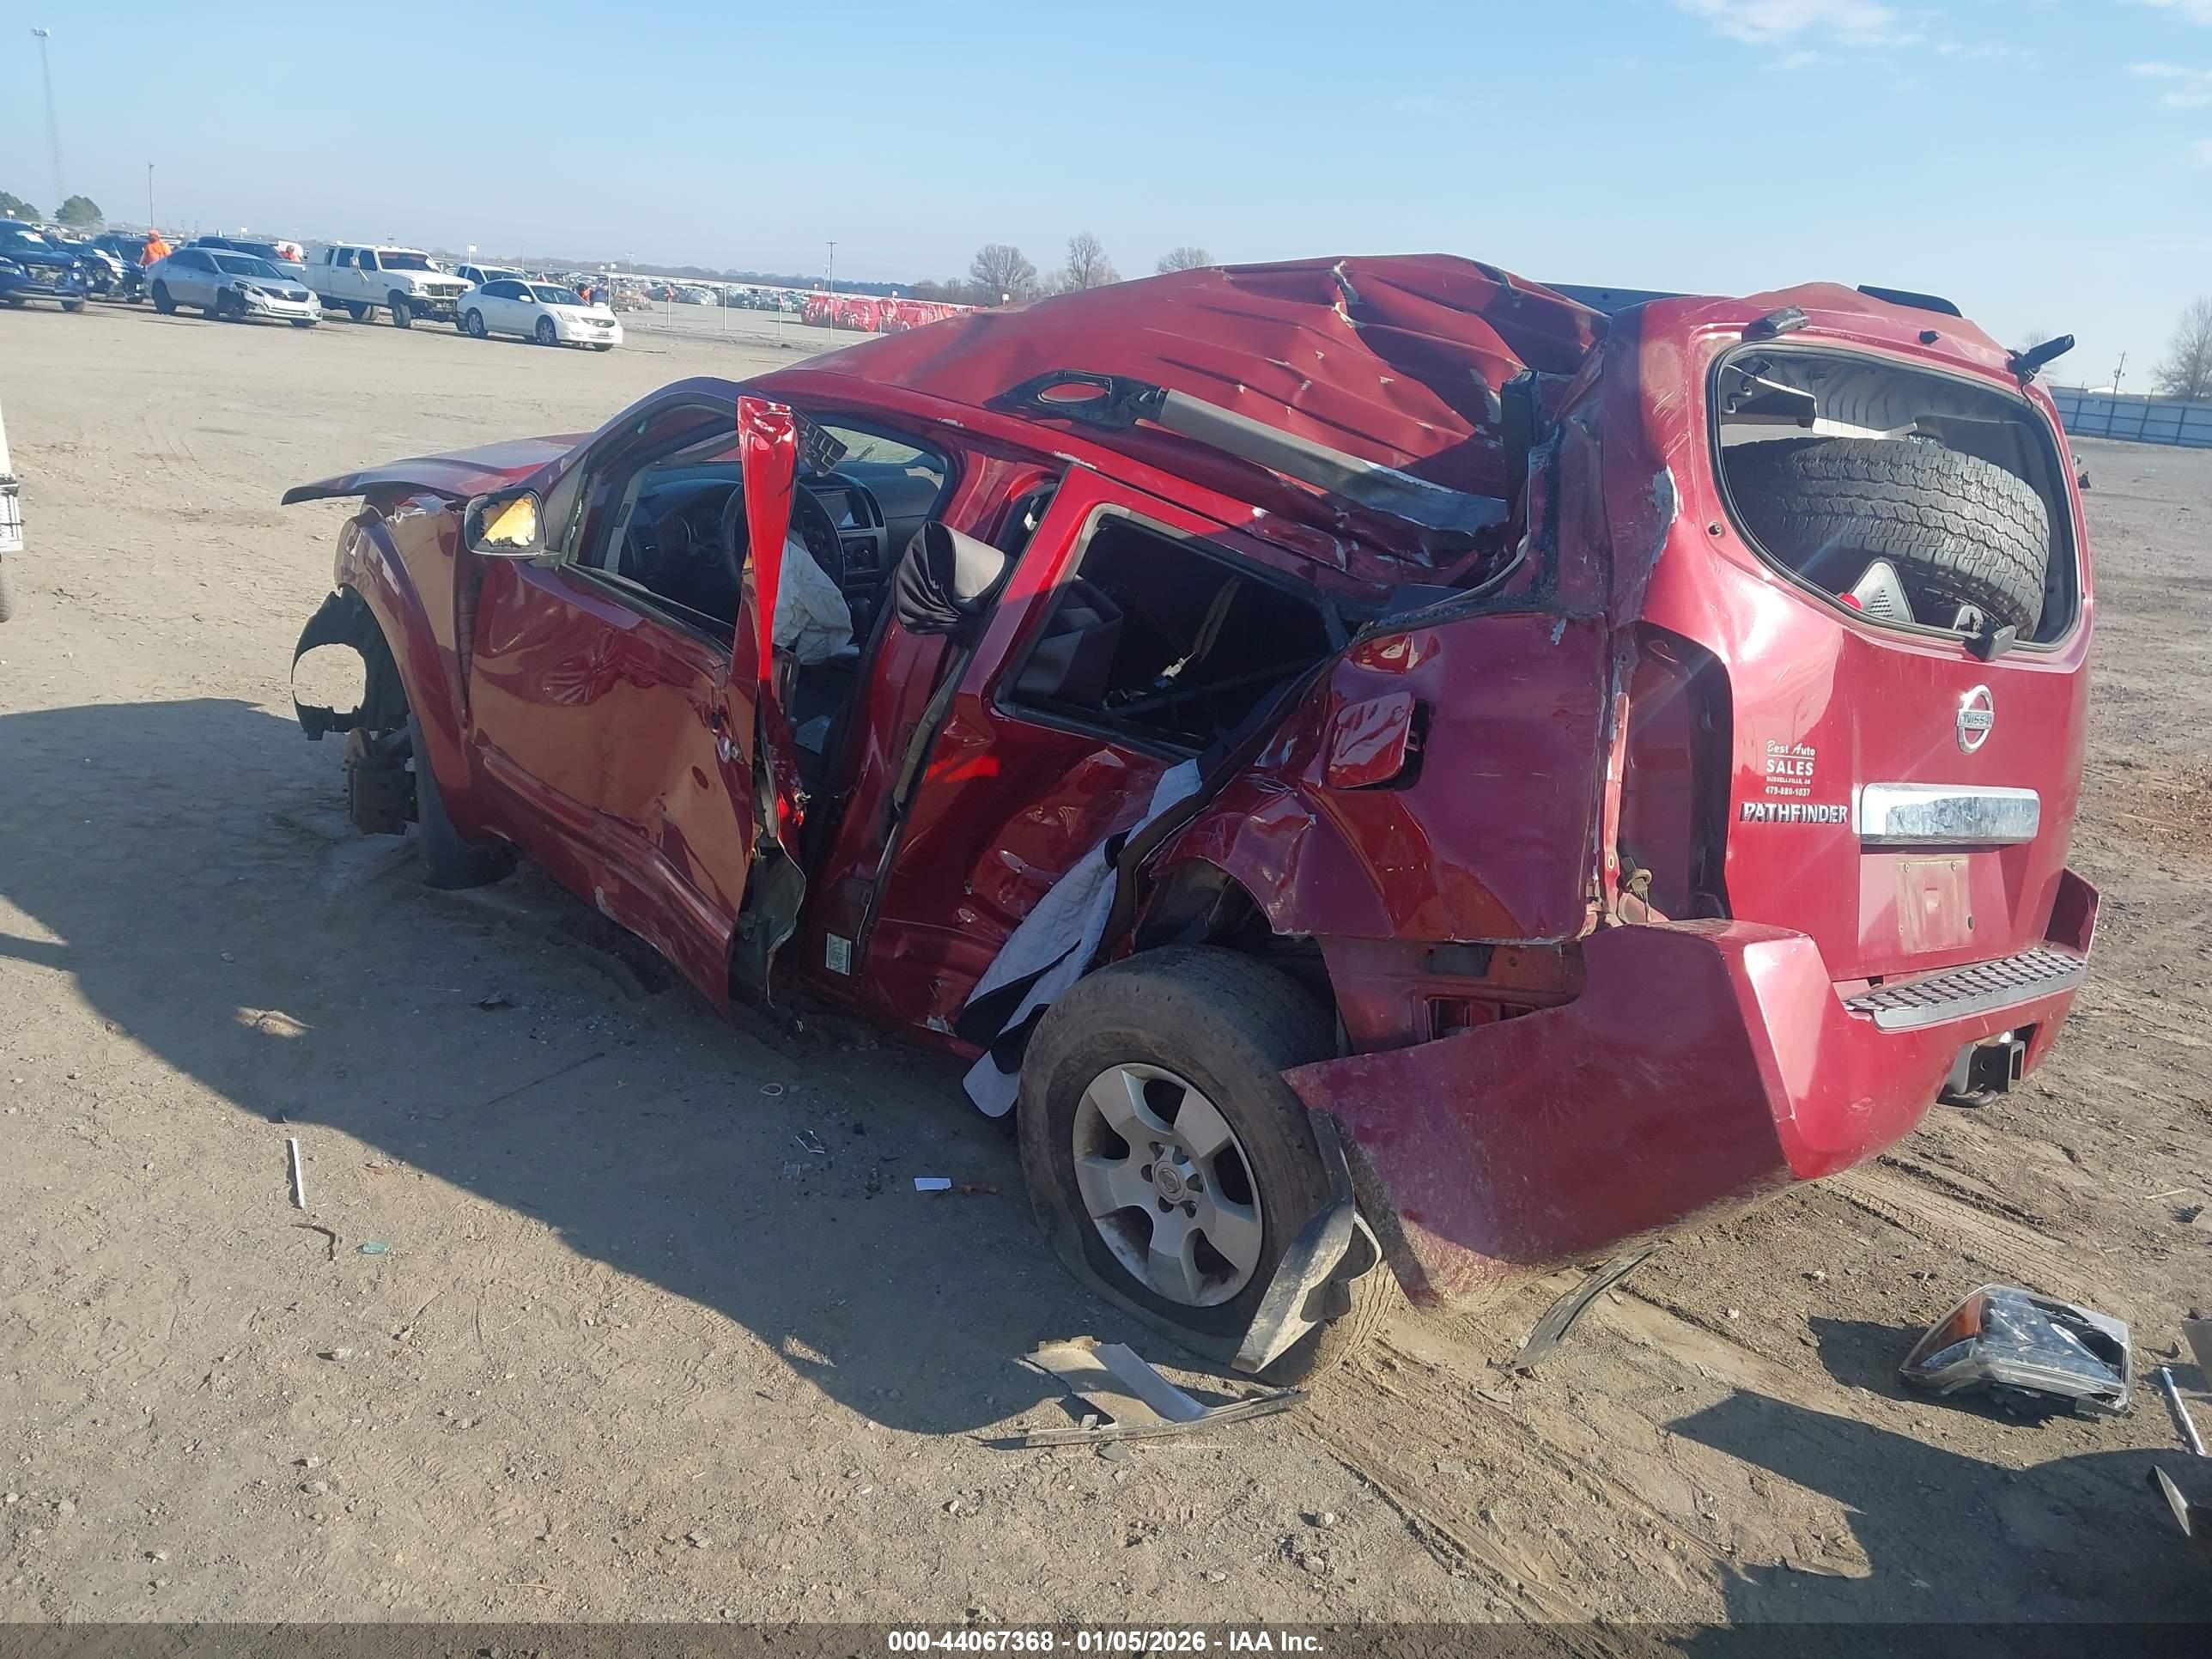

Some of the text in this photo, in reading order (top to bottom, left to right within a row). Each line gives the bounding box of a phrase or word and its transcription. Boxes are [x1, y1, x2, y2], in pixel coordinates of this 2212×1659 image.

[1766, 739, 1815, 756] Best Auto
[1765, 758, 1814, 776] SALES
[1740, 802, 1848, 823] PATHFINDER
